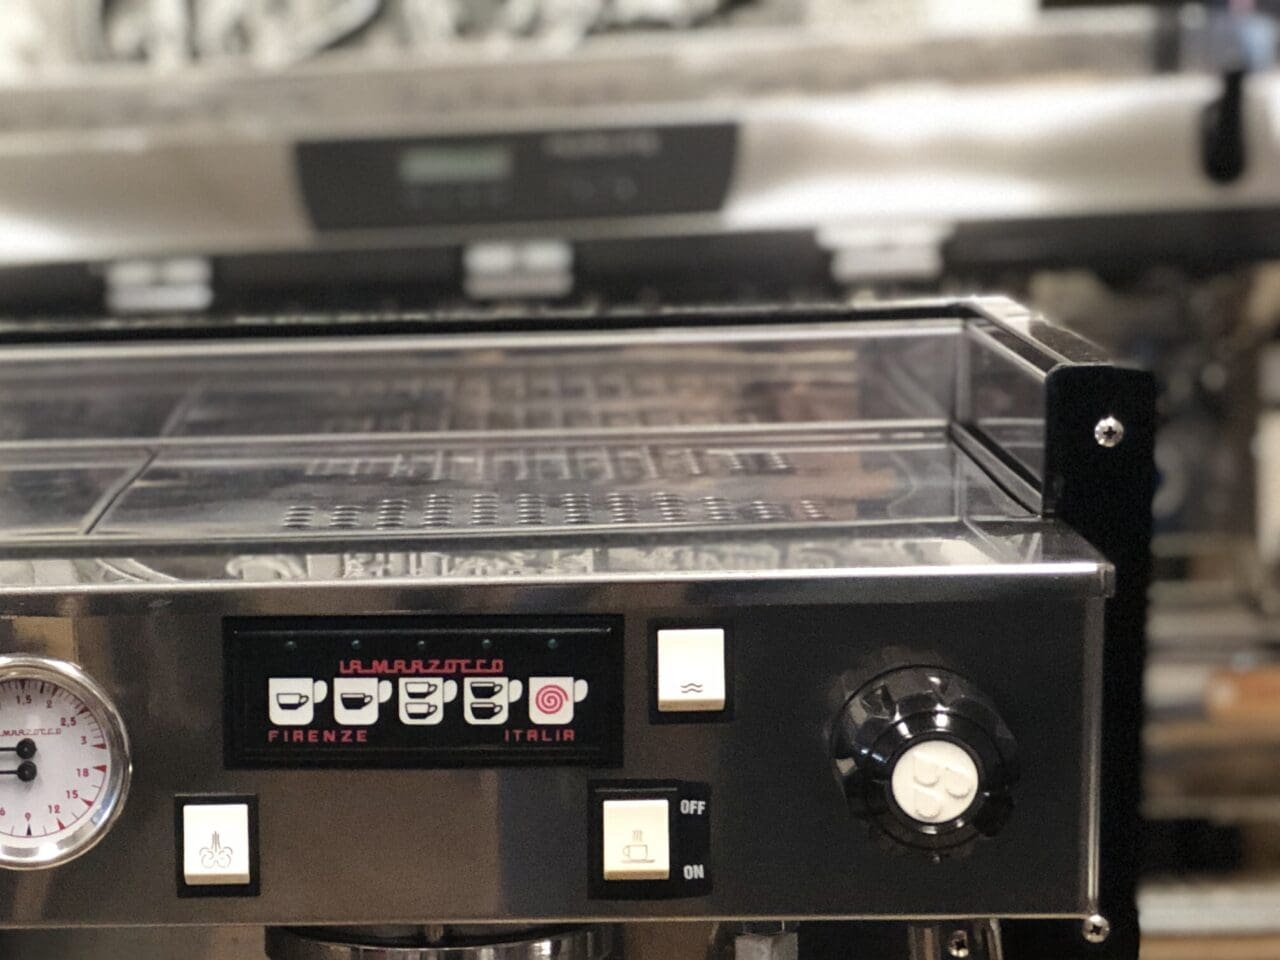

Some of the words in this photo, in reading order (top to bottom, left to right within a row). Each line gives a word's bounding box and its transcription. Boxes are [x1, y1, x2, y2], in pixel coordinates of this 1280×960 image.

[268, 729, 368, 743] FIRENZE
[504, 728, 575, 741] ITALIA
[76, 768, 89, 777] 18
[66, 790, 79, 799] 15
[48, 804, 61, 813] 12
[680, 799, 706, 815] OFF
[683, 864, 705, 880] ON
